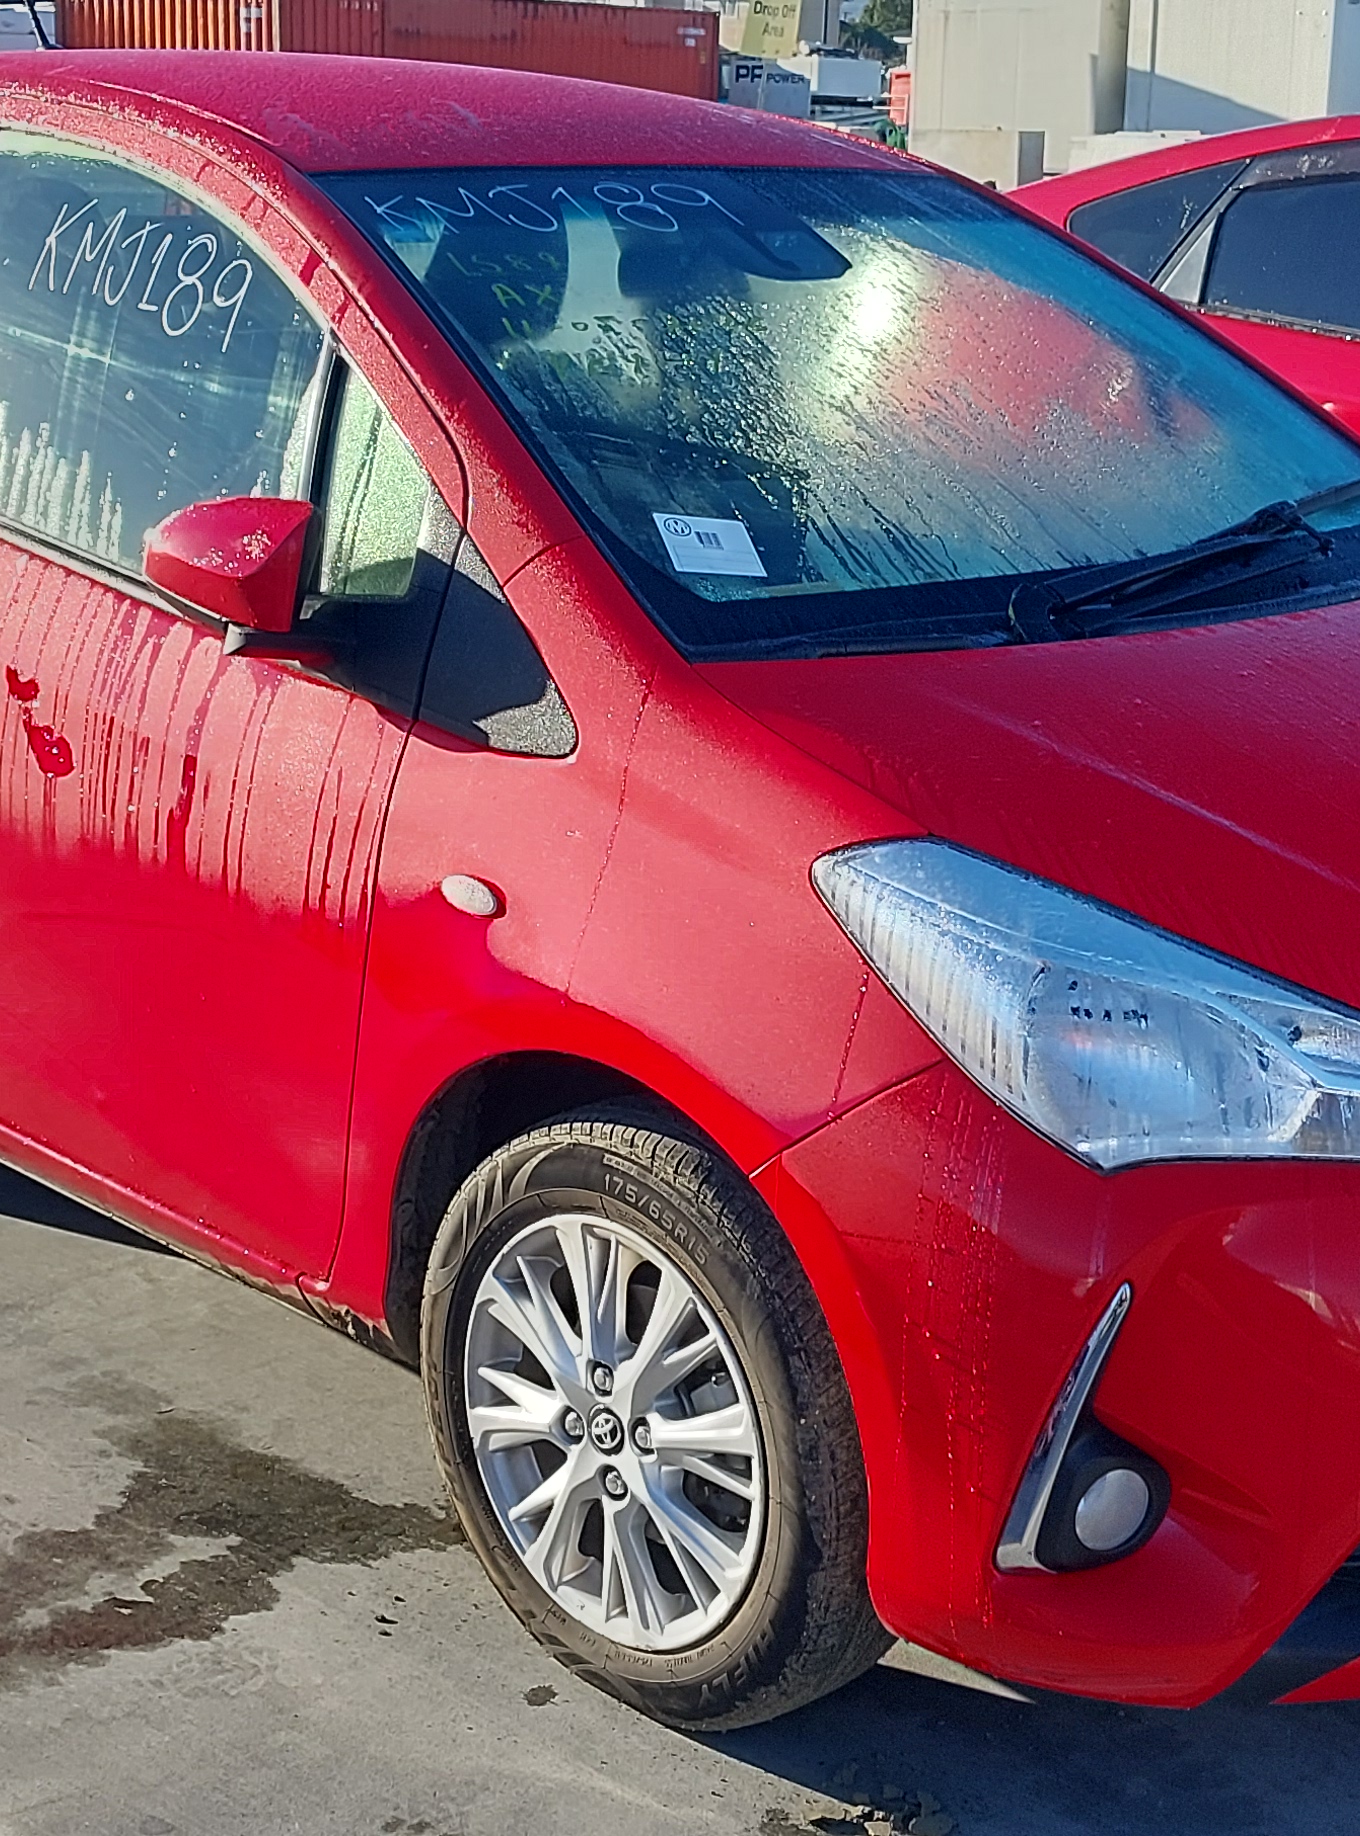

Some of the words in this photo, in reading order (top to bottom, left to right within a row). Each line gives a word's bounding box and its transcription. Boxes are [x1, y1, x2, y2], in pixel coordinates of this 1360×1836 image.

[753, 0, 780, 18] Drop
[762, 22, 785, 37] Area
[735, 64, 764, 83] PF
[766, 73, 805, 84] POWER
[364, 182, 746, 235] KMJ189
[28, 198, 254, 354] KMJ189
[604, 1172, 710, 1266] 175/65R15
